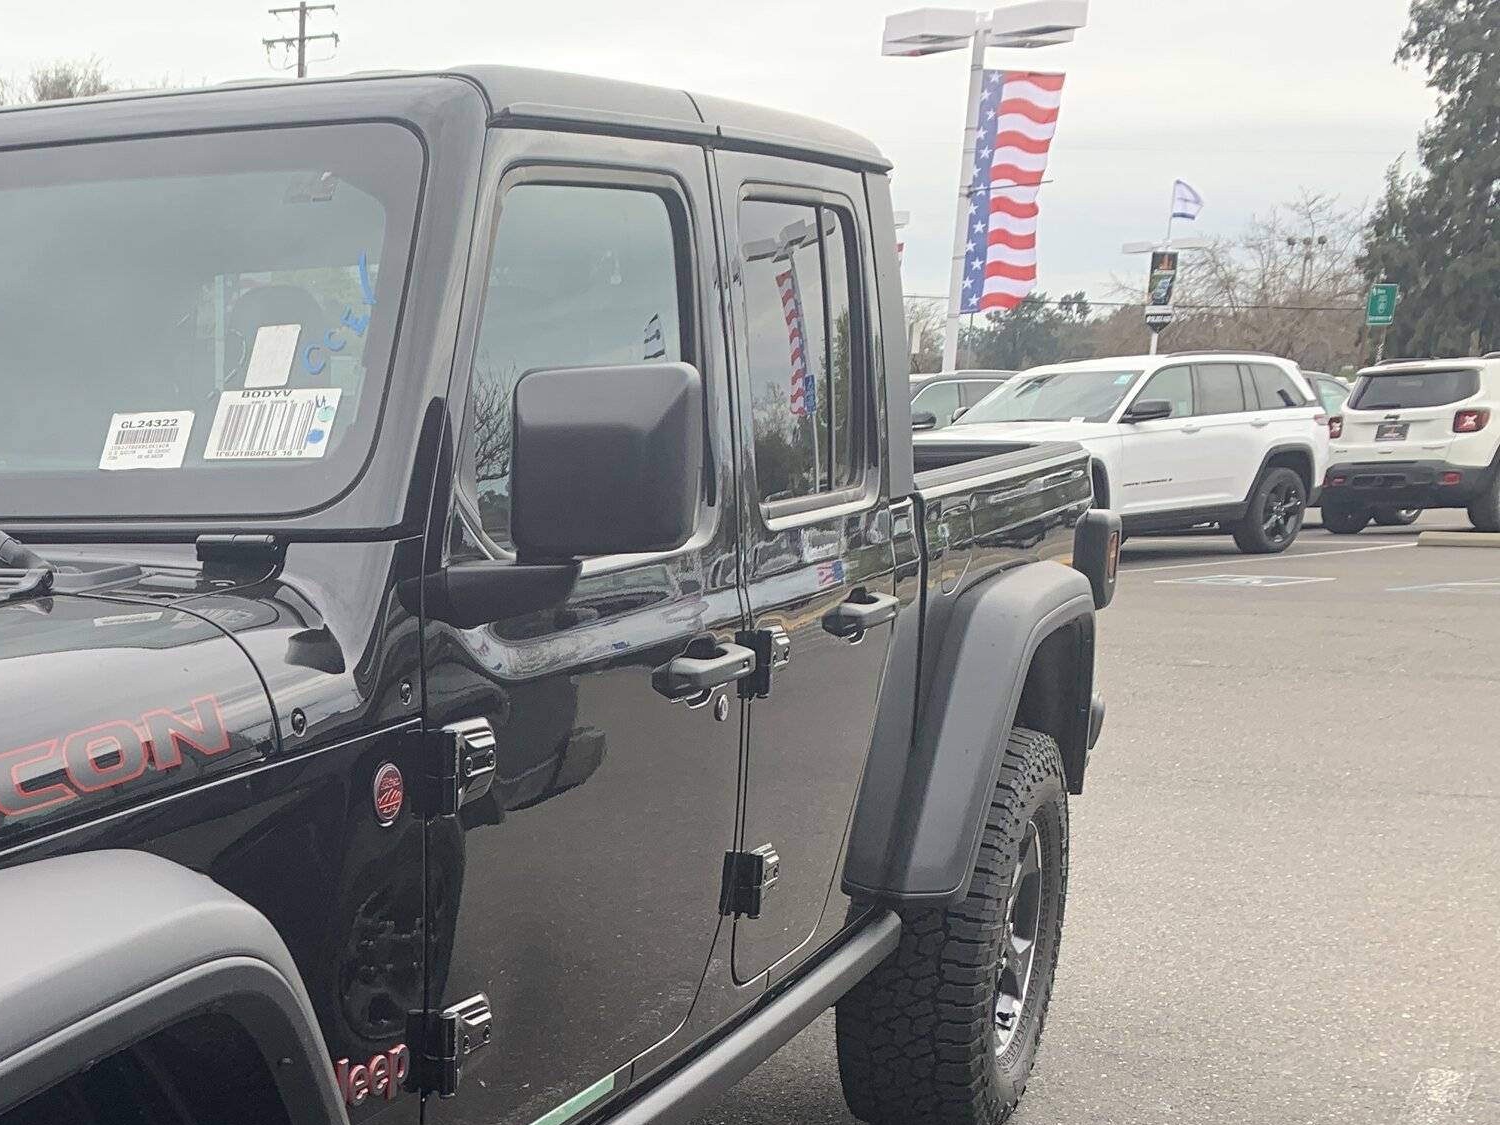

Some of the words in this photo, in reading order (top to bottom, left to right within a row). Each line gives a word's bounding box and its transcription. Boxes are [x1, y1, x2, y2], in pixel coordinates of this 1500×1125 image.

[241, 389, 293, 399] BODYV
[120, 418, 179, 430] GL24322
[335, 1043, 411, 1107] Jeep
